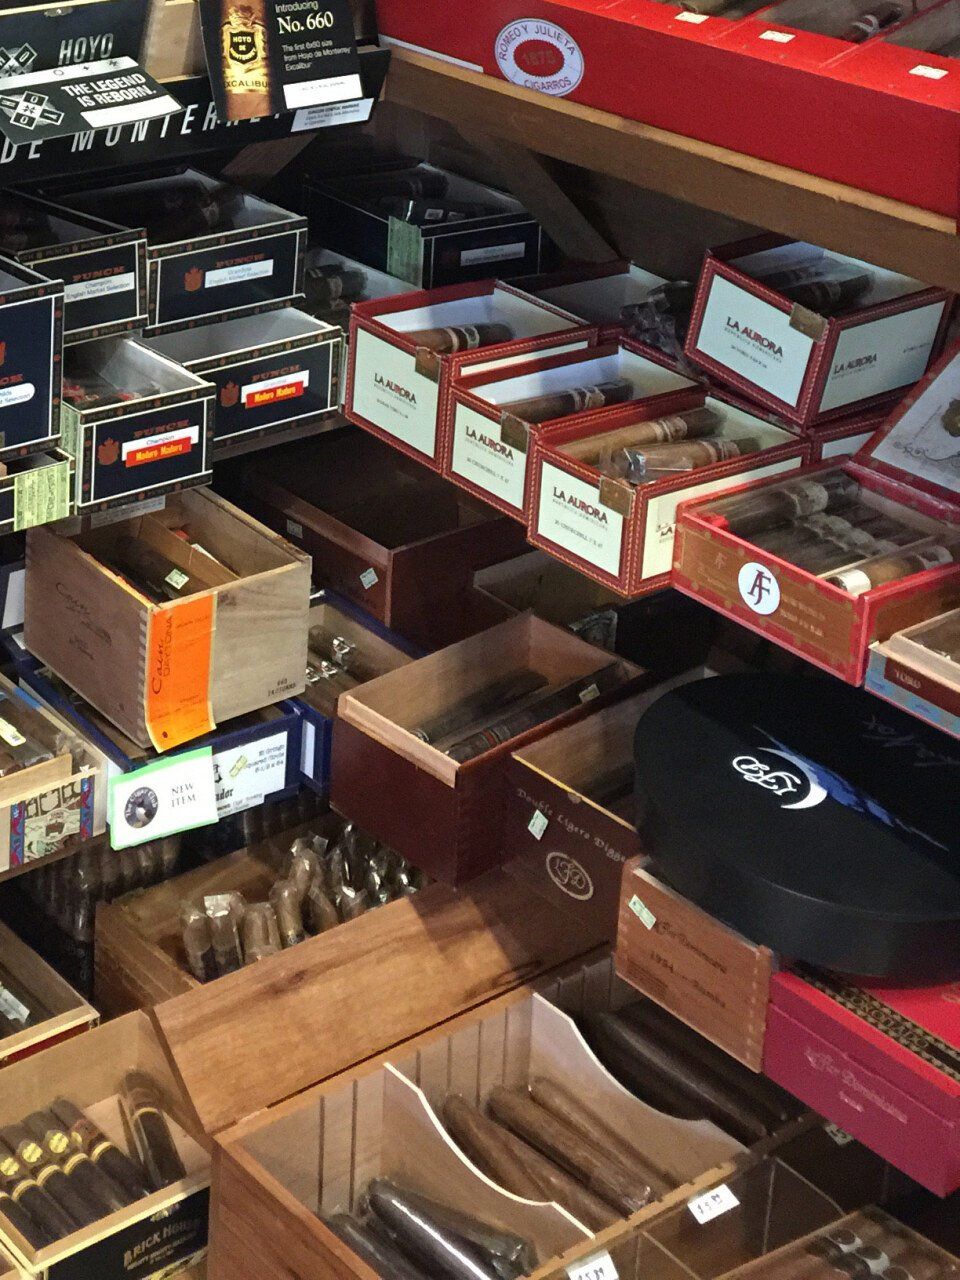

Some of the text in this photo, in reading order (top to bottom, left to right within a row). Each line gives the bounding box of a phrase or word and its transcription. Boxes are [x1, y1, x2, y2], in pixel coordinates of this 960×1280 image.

[274, 0, 319, 14] Introducing
[277, 11, 334, 35] No. 660
[57, 32, 114, 65] HOYO
[282, 44, 293, 53] The
[499, 24, 576, 61] ROMEO Y JULIETA
[283, 50, 322, 63] from Hoyo de
[61, 73, 147, 97] THE LEGEND
[523, 76, 572, 91] CIGARROS
[77, 83, 157, 107] IS REBORN.
[215, 252, 266, 268] PUNCH
[71, 264, 125, 282] PUNCH
[726, 316, 783, 358] LA AURORA
[251, 364, 300, 381] PUNCH
[833, 353, 878, 375] LA AURORA
[254, 385, 296, 403] Maduro Maduro
[374, 372, 417, 404] LA AURORA
[133, 419, 190, 438] PUNCH
[135, 443, 183, 462] Maduro Maduro
[465, 425, 514, 461] LA AURORA
[553, 486, 608, 525] LA AURORA
[171, 783, 195, 795] NEW
[171, 794, 197, 809] ITEM
[123, 1232, 161, 1269] BRICK
